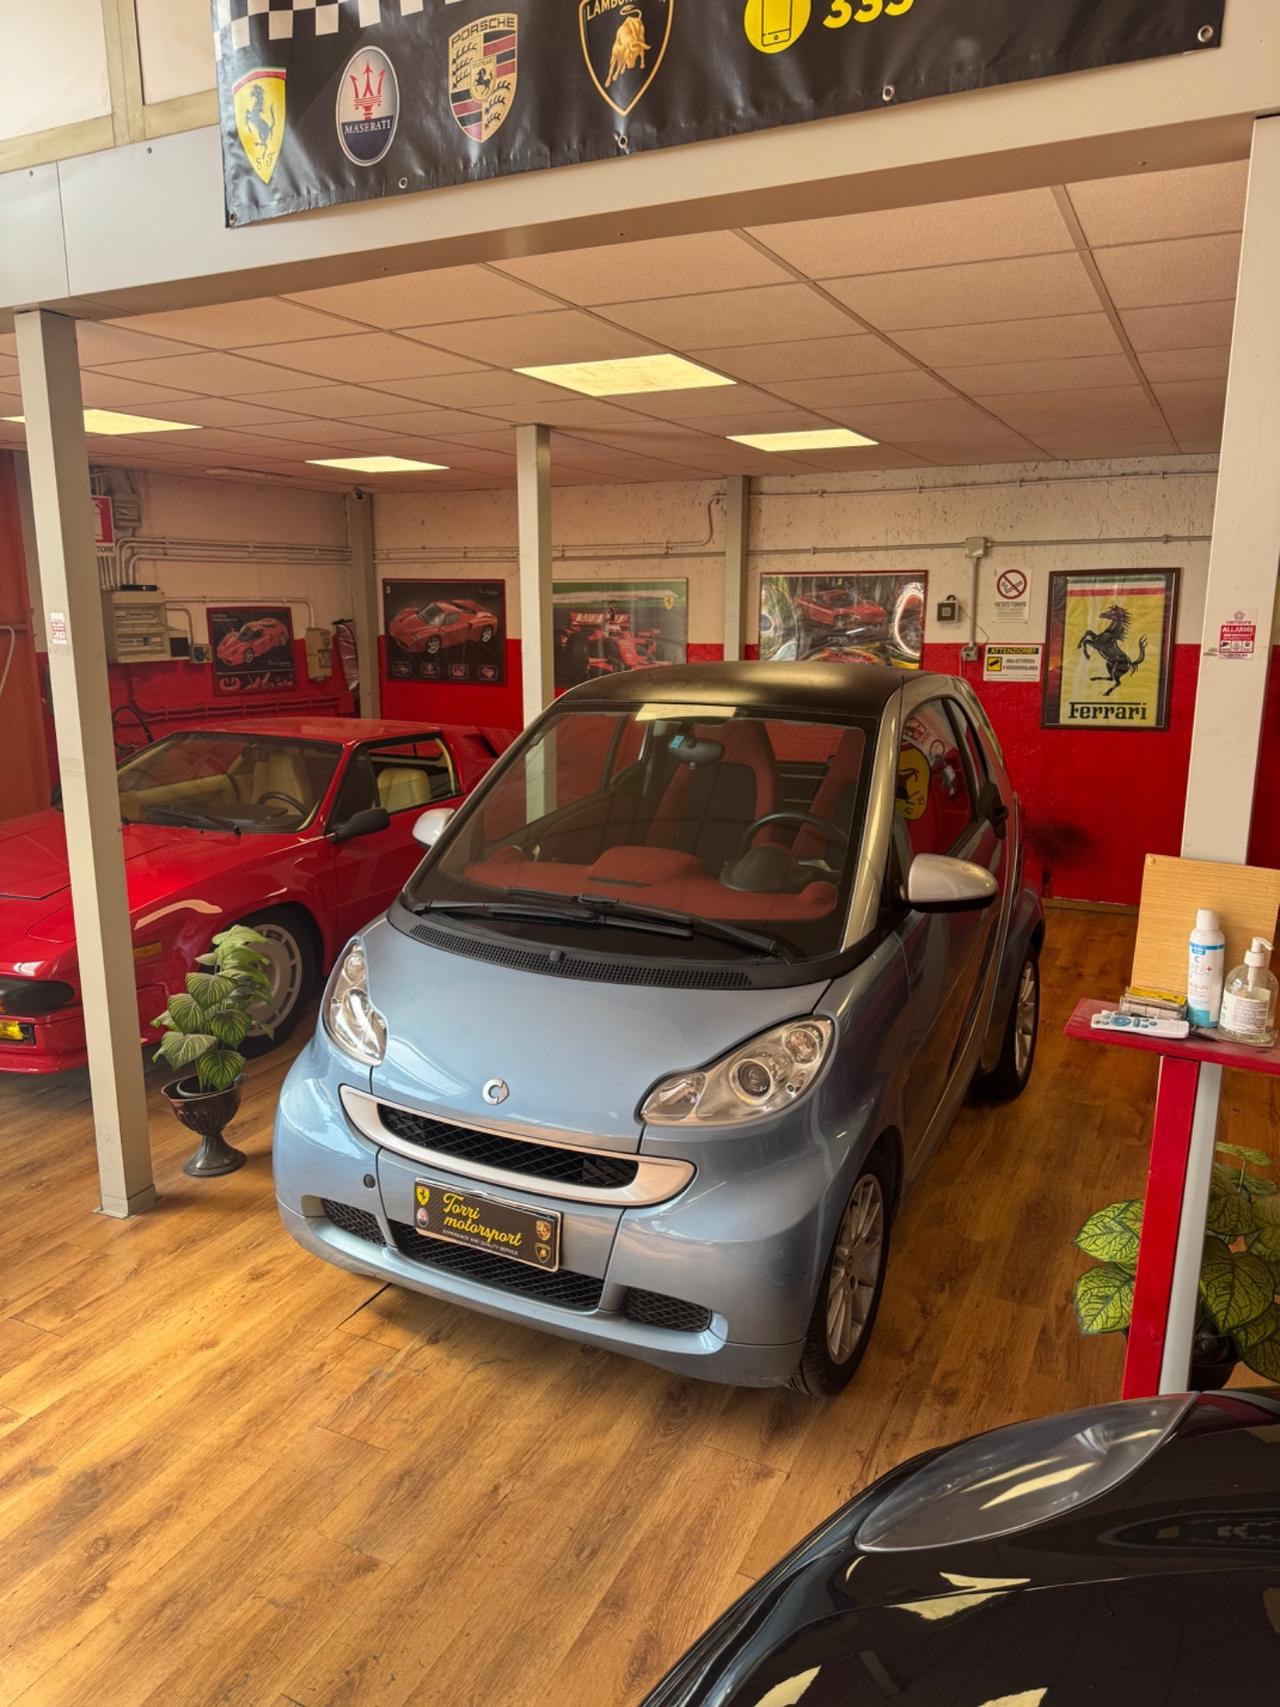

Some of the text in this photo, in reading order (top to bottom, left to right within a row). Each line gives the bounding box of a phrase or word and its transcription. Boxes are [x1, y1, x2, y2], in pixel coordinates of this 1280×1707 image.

[451, 17, 515, 48] PORSCHE
[344, 119, 391, 135] MASERATI
[1068, 701, 1147, 720] Ferrari
[442, 1192, 480, 1220] Torri
[443, 1215, 522, 1247] motorsport
